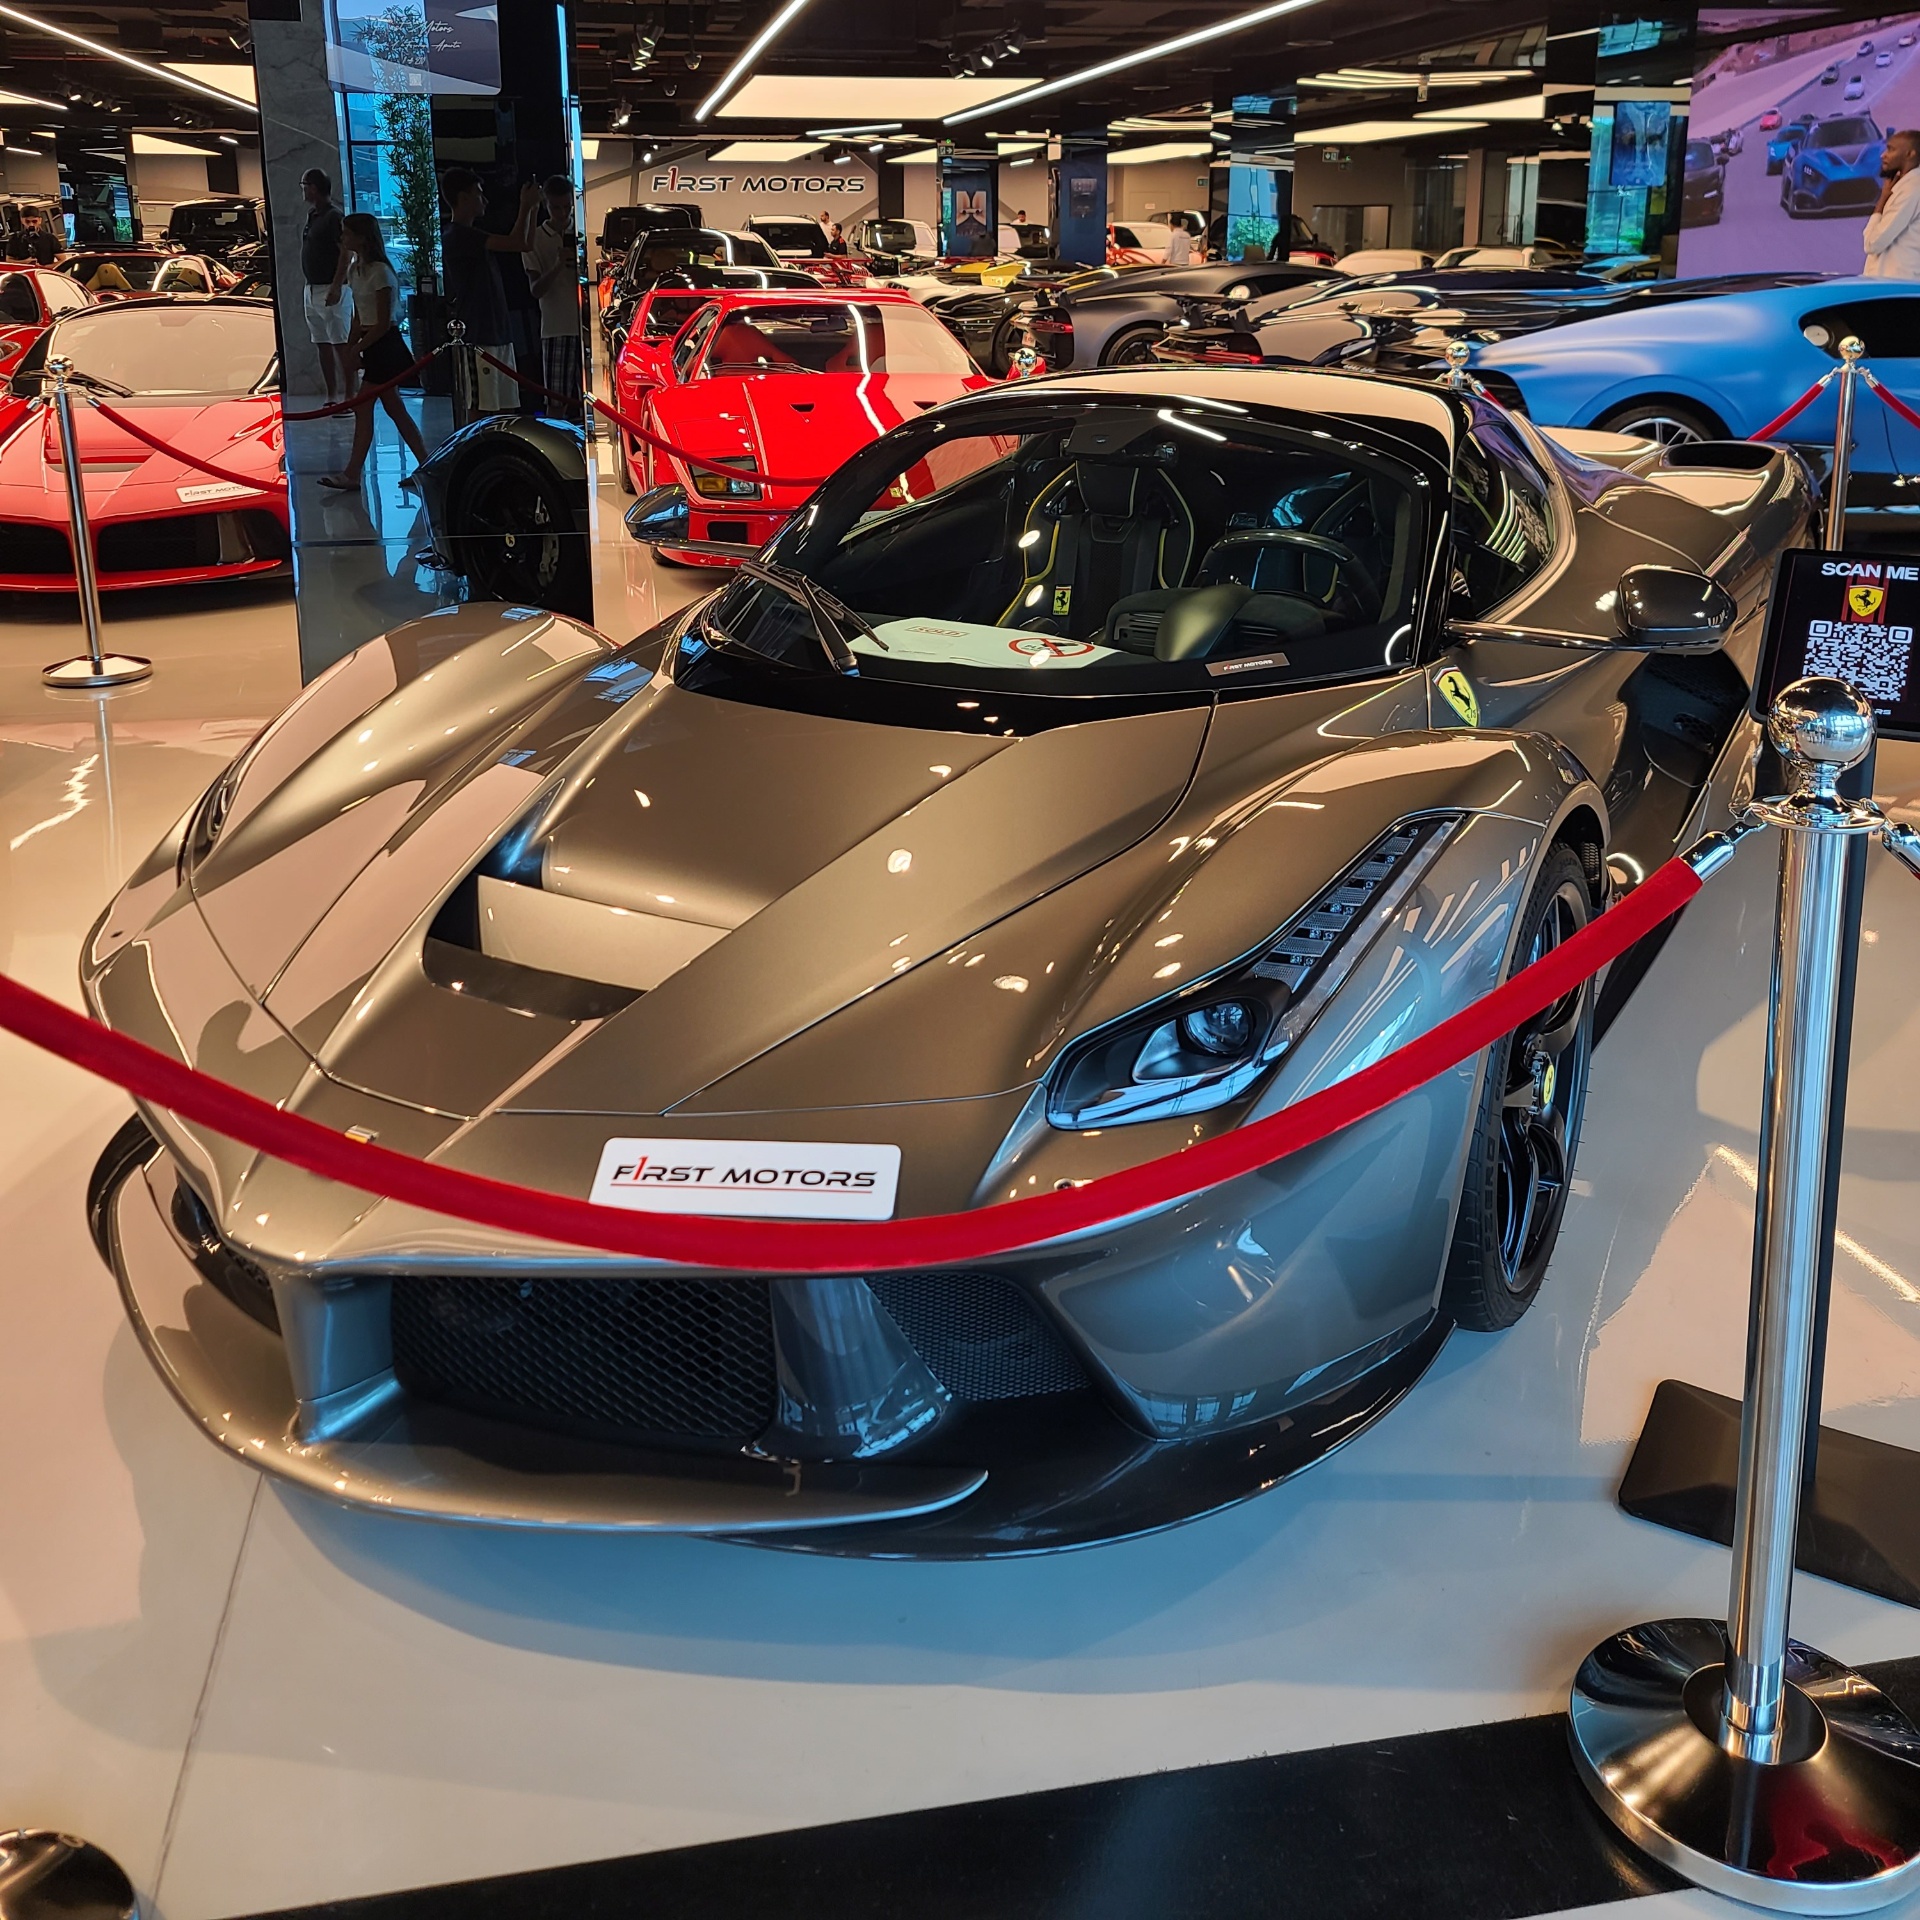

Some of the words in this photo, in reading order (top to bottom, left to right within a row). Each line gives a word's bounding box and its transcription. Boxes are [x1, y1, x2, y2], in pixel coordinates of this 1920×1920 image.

[741, 176, 866, 193] MOTORS
[215, 485, 245, 493] MOTO
[1821, 562, 1882, 578] SCAN
[1886, 566, 1919, 581] ME
[1244, 659, 1274, 668] MOTORS
[720, 1168, 878, 1187] MOTORS
